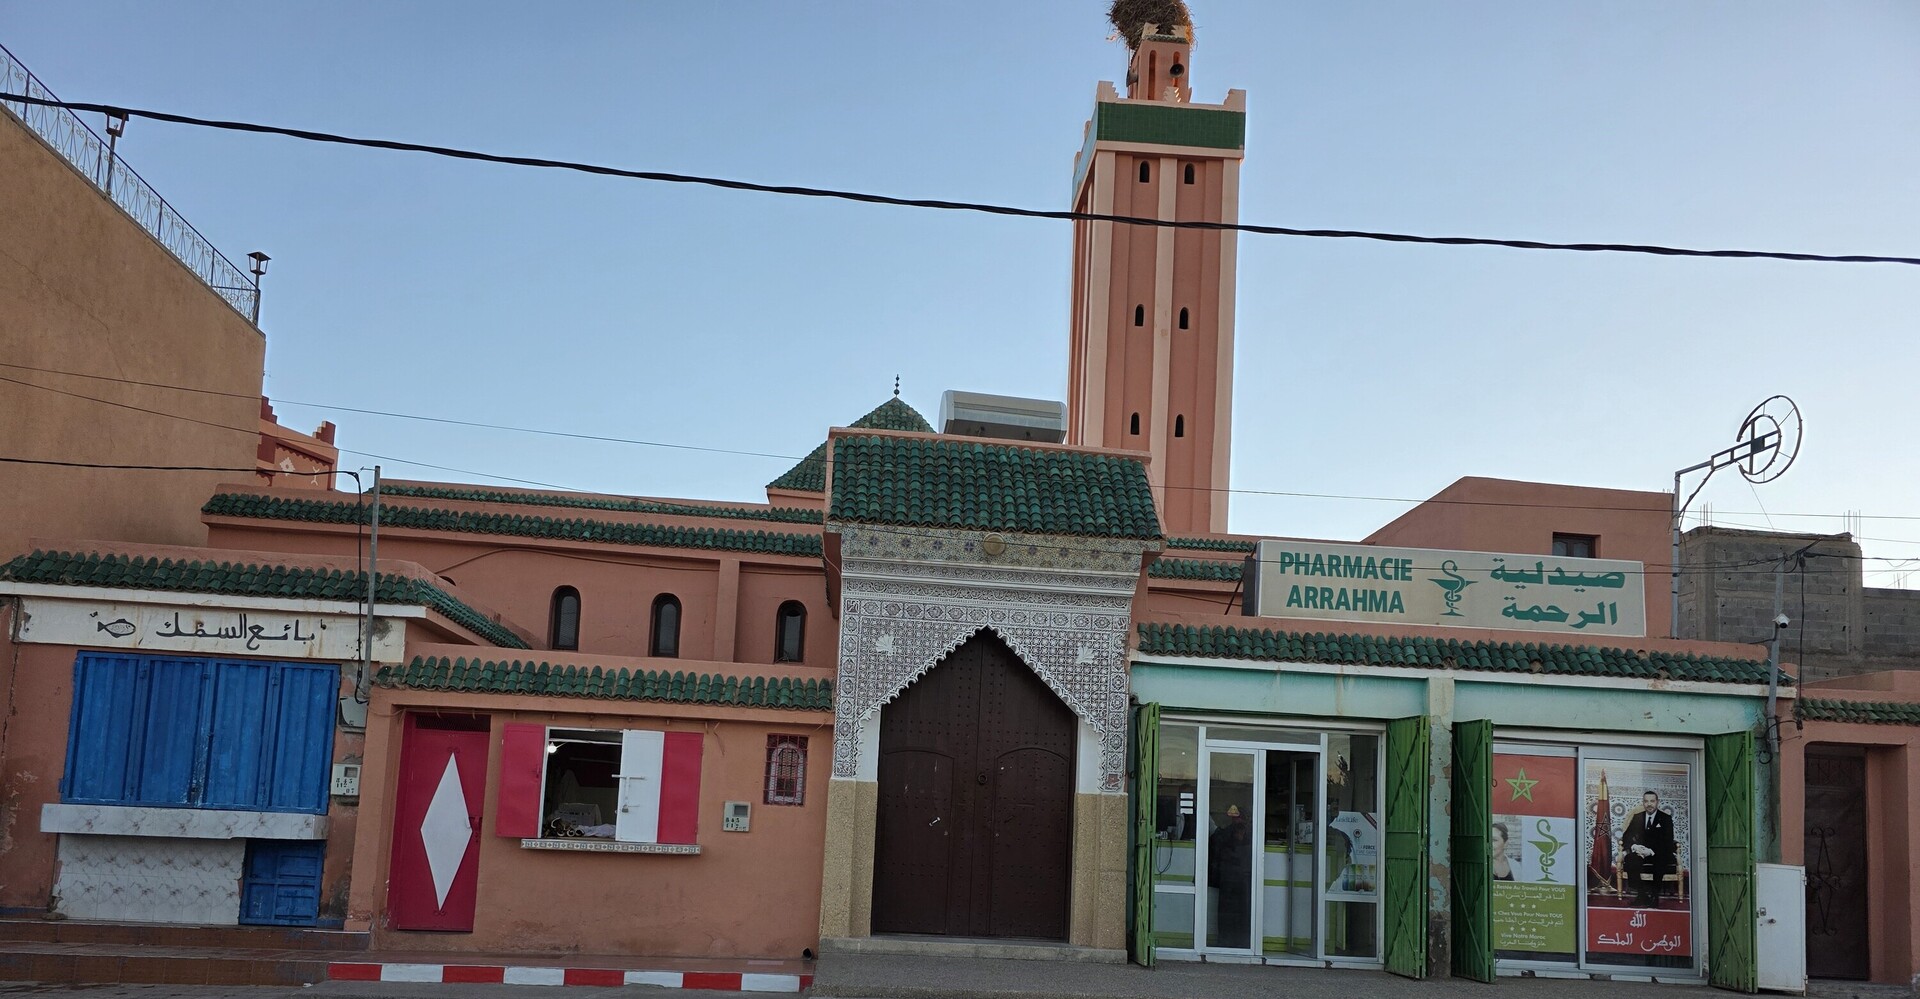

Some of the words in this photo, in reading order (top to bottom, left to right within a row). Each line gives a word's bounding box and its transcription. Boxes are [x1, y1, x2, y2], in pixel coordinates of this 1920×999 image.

[1280, 552, 1412, 581] PHARMACIE
[1490, 557, 1626, 593] صيدلية
[1286, 585, 1404, 613] ARRAHMA
[1502, 596, 1618, 629] الرحمة
[156, 612, 248, 639] السمك
[246, 618, 315, 650] بائع
[1630, 910, 1647, 928] الله
[1597, 932, 1633, 946] الملك
[1641, 934, 1681, 952] الوطن
